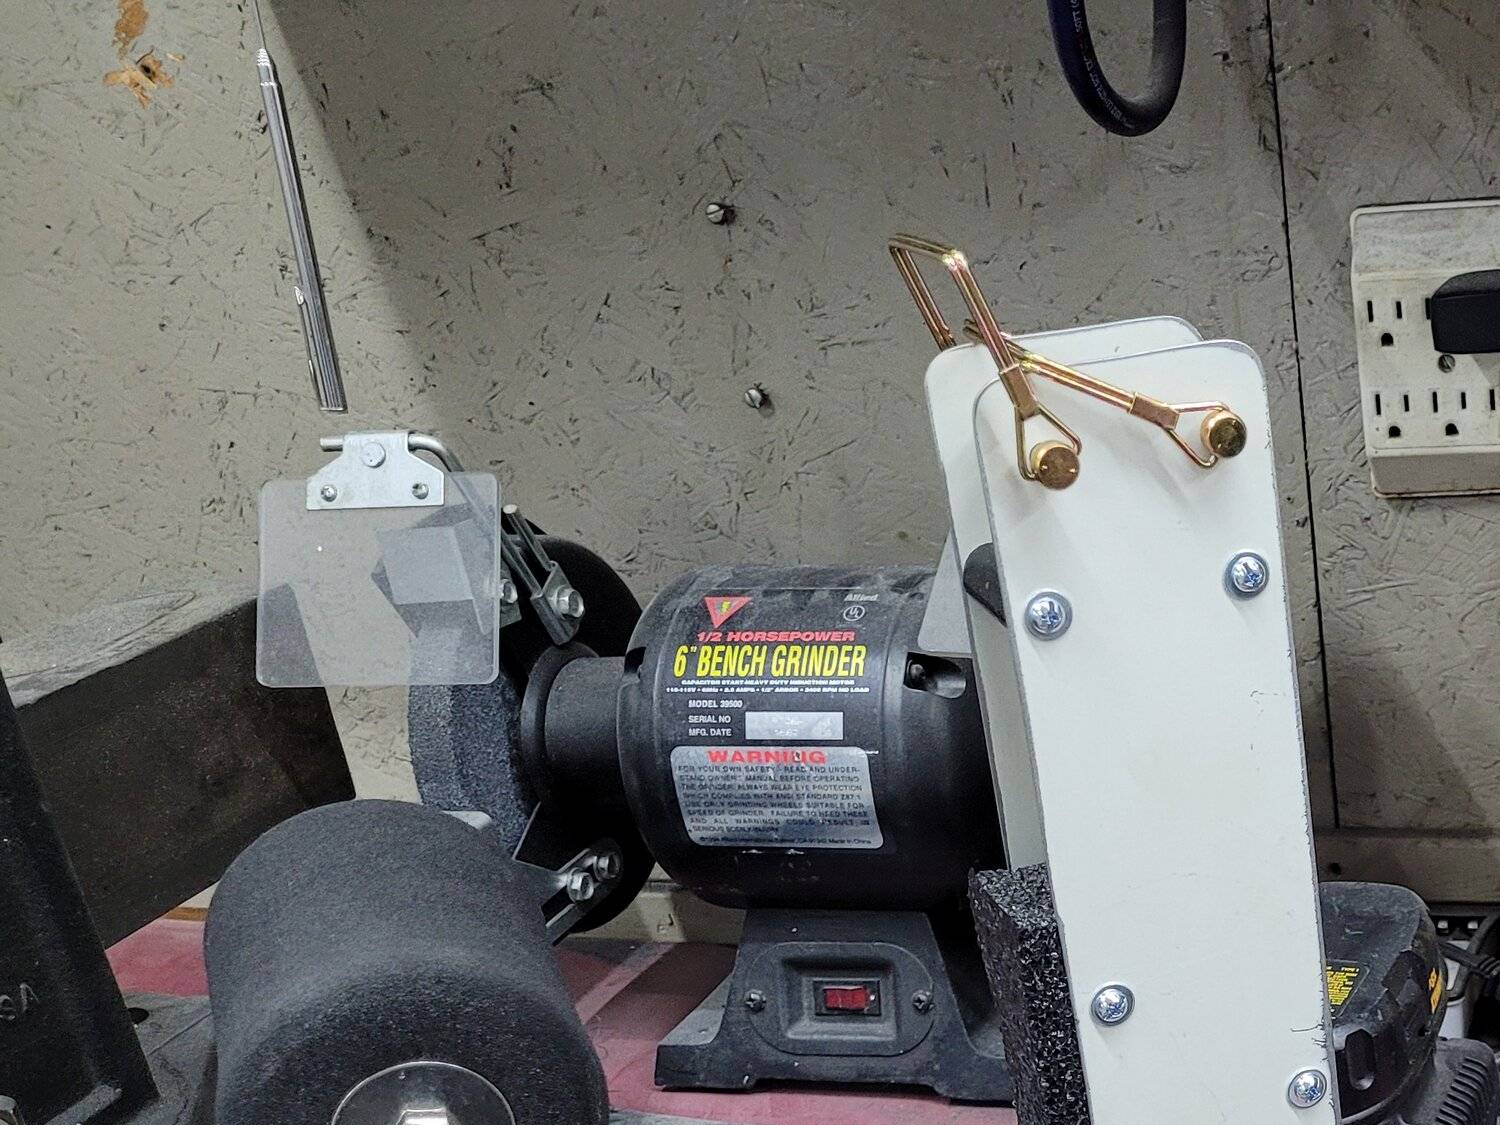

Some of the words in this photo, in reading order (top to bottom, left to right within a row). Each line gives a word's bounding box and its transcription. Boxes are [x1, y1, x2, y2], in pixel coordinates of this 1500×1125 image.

[696, 631, 722, 642] 1/2
[726, 631, 856, 642] HORSEPOWER
[697, 645, 767, 677] BENCH
[770, 645, 867, 677] GRINDER
[688, 700, 718, 708] MODEL
[688, 715, 717, 723] SERIAL
[718, 715, 731, 723] NO
[688, 728, 709, 736] MFG.
[710, 728, 732, 736] DATE
[707, 750, 826, 764] WARNING
